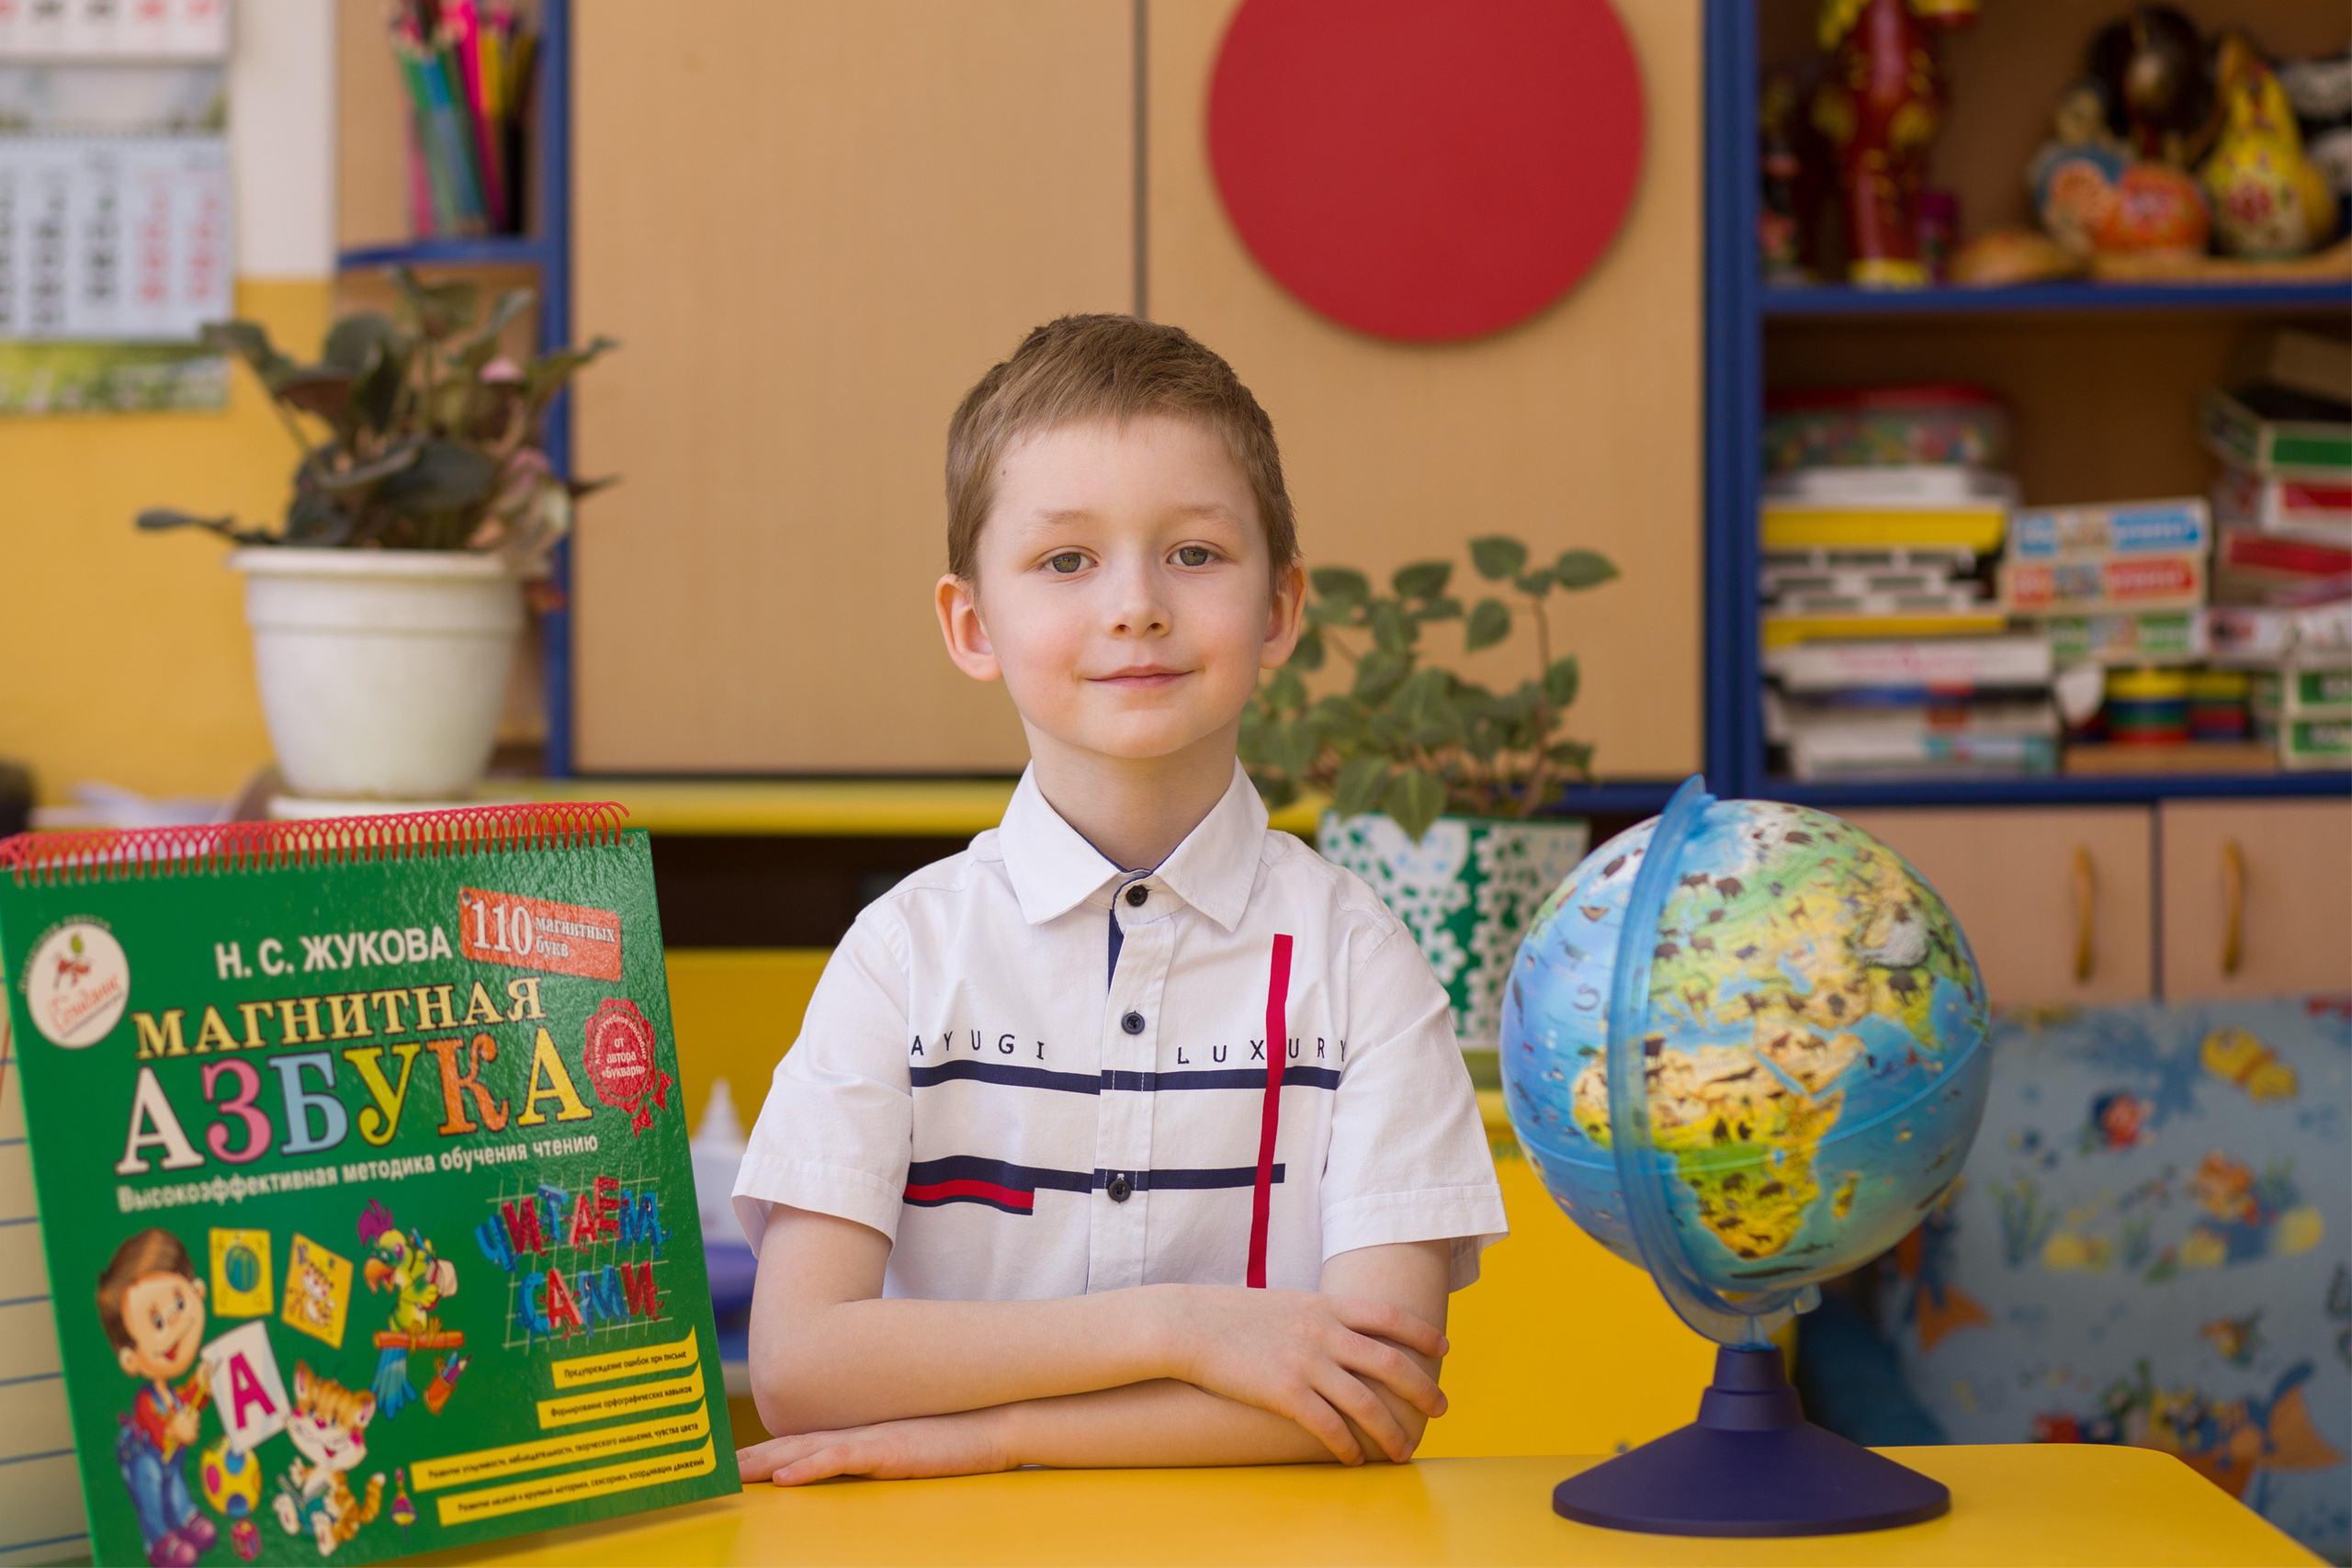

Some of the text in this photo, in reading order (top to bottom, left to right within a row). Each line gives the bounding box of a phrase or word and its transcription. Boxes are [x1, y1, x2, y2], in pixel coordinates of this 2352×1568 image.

[471, 898, 533, 956] 110
[535, 917, 616, 942] магнитных
[214, 924, 453, 980] Н. С. ЖУКОВА
[536, 934, 569, 959] букв
[130, 976, 548, 1061] МАГНИТНАЯ
[606, 1051, 637, 1064] автора
[614, 1037, 624, 1048] от
[910, 1029, 1346, 1065] AYUGI LUXURY
[114, 1026, 594, 1177] АЗБУКА
[116, 1134, 599, 1213] Высокоэффективная методика обучения чтению
[474, 1176, 665, 1271] ЧИТАЕМ
[518, 1260, 659, 1332] САМИ
[564, 1350, 687, 1379] Предупреждение ошибок при письме
[229, 1350, 277, 1430] А
[604, 1391, 663, 1409] орфографических
[664, 1385, 693, 1396] навыков
[574, 1438, 617, 1452] творческого
[654, 1427, 679, 1439] чувства
[680, 1423, 699, 1433] цвета
[629, 1464, 673, 1479] координации
[673, 1457, 705, 1472] движений
